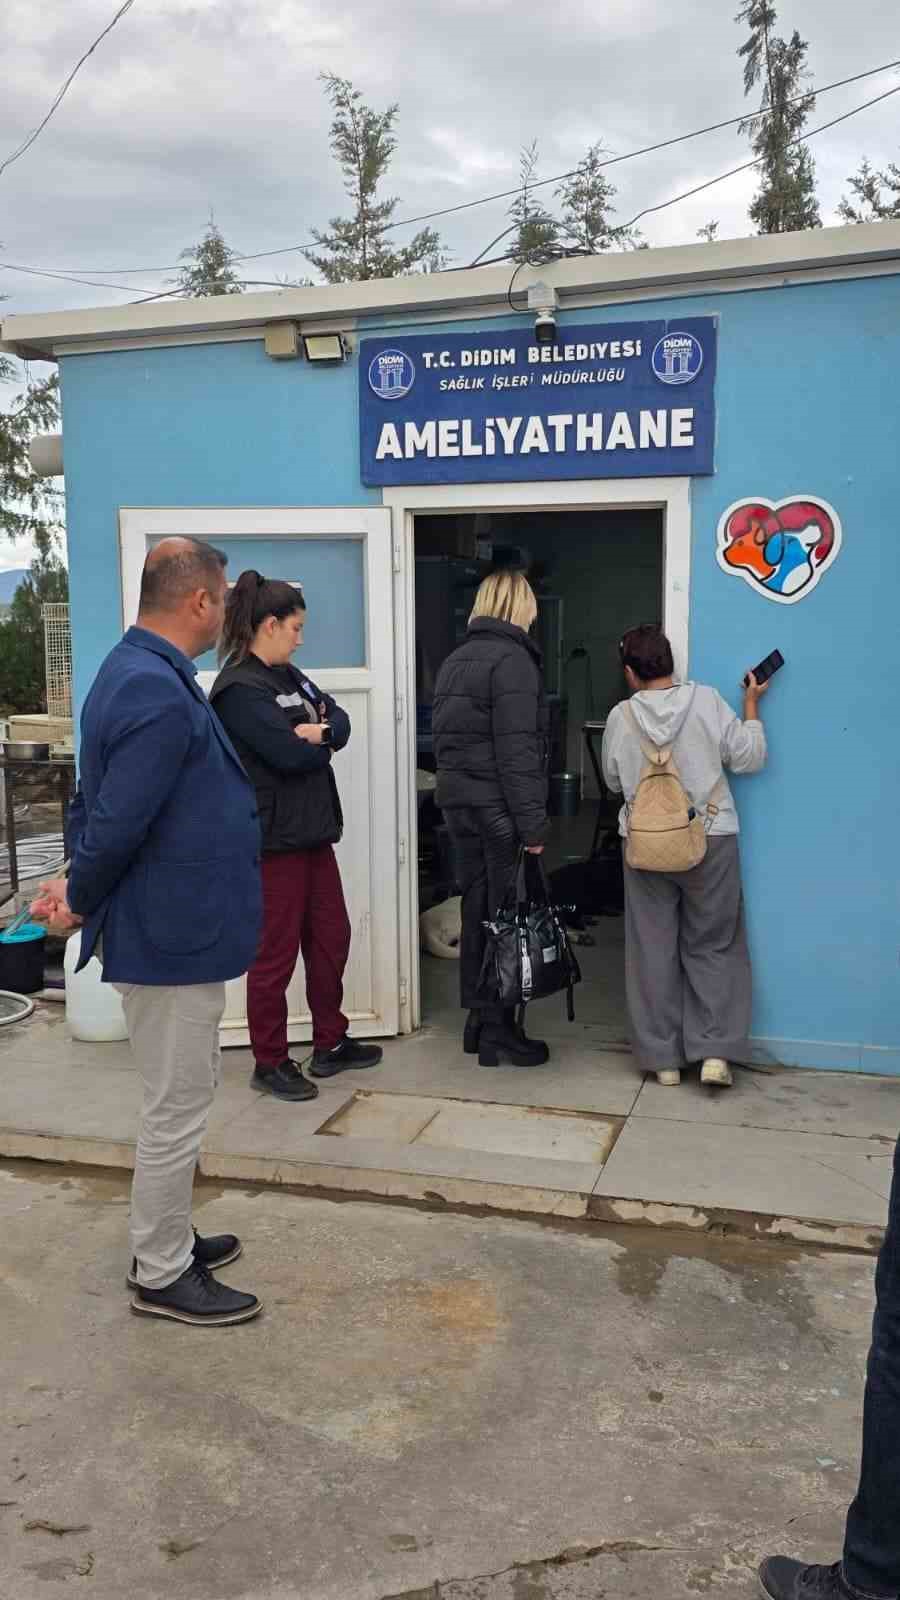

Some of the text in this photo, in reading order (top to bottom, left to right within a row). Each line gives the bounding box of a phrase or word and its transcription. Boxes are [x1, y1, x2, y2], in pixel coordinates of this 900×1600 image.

[422, 351, 456, 369] T.C.
[439, 375, 485, 391] SAĞLIK
[541, 368, 625, 386] MÜDÜRLÜĞÜ
